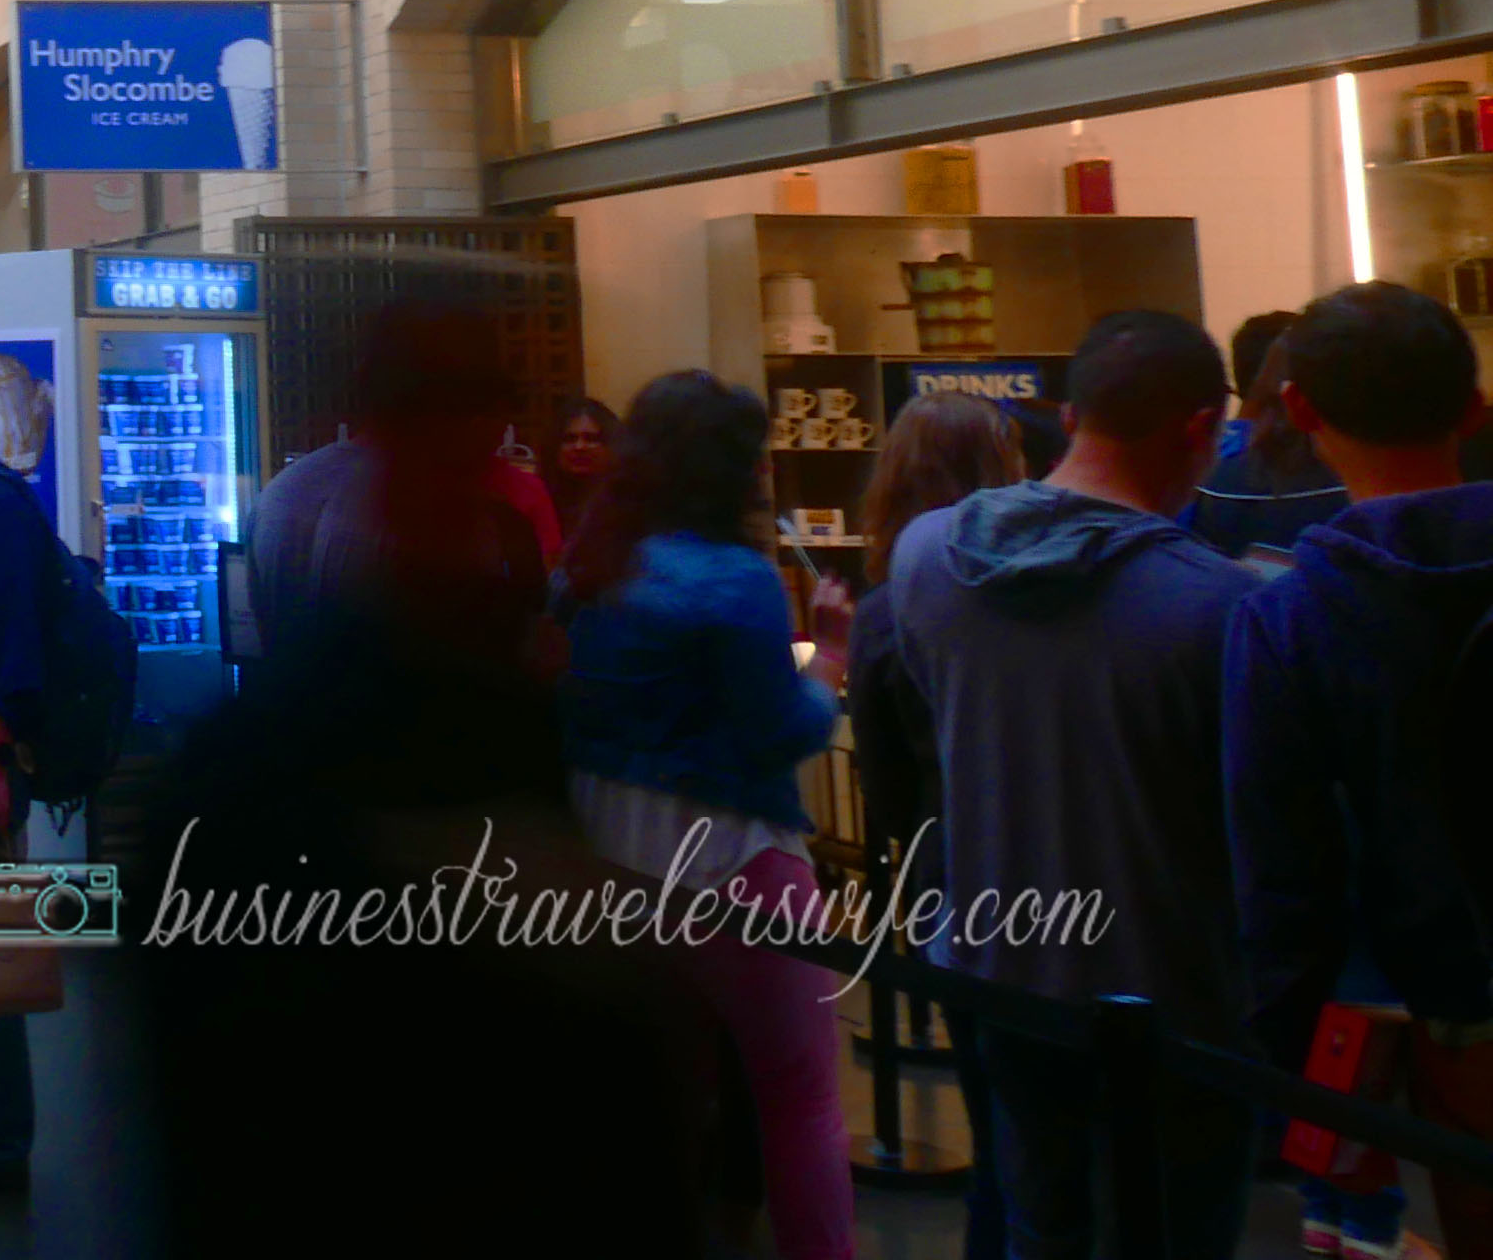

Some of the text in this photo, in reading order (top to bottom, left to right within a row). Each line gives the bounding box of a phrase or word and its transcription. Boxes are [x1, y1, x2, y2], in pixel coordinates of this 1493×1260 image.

[29, 39, 176, 76] Humphry
[63, 73, 215, 102] Slocombe
[90, 112, 189, 126] ICE CREAM
[95, 259, 253, 282] SKIP THE LINE
[112, 281, 238, 310] GRAB & GO
[916, 373, 1038, 399] DRINKS
